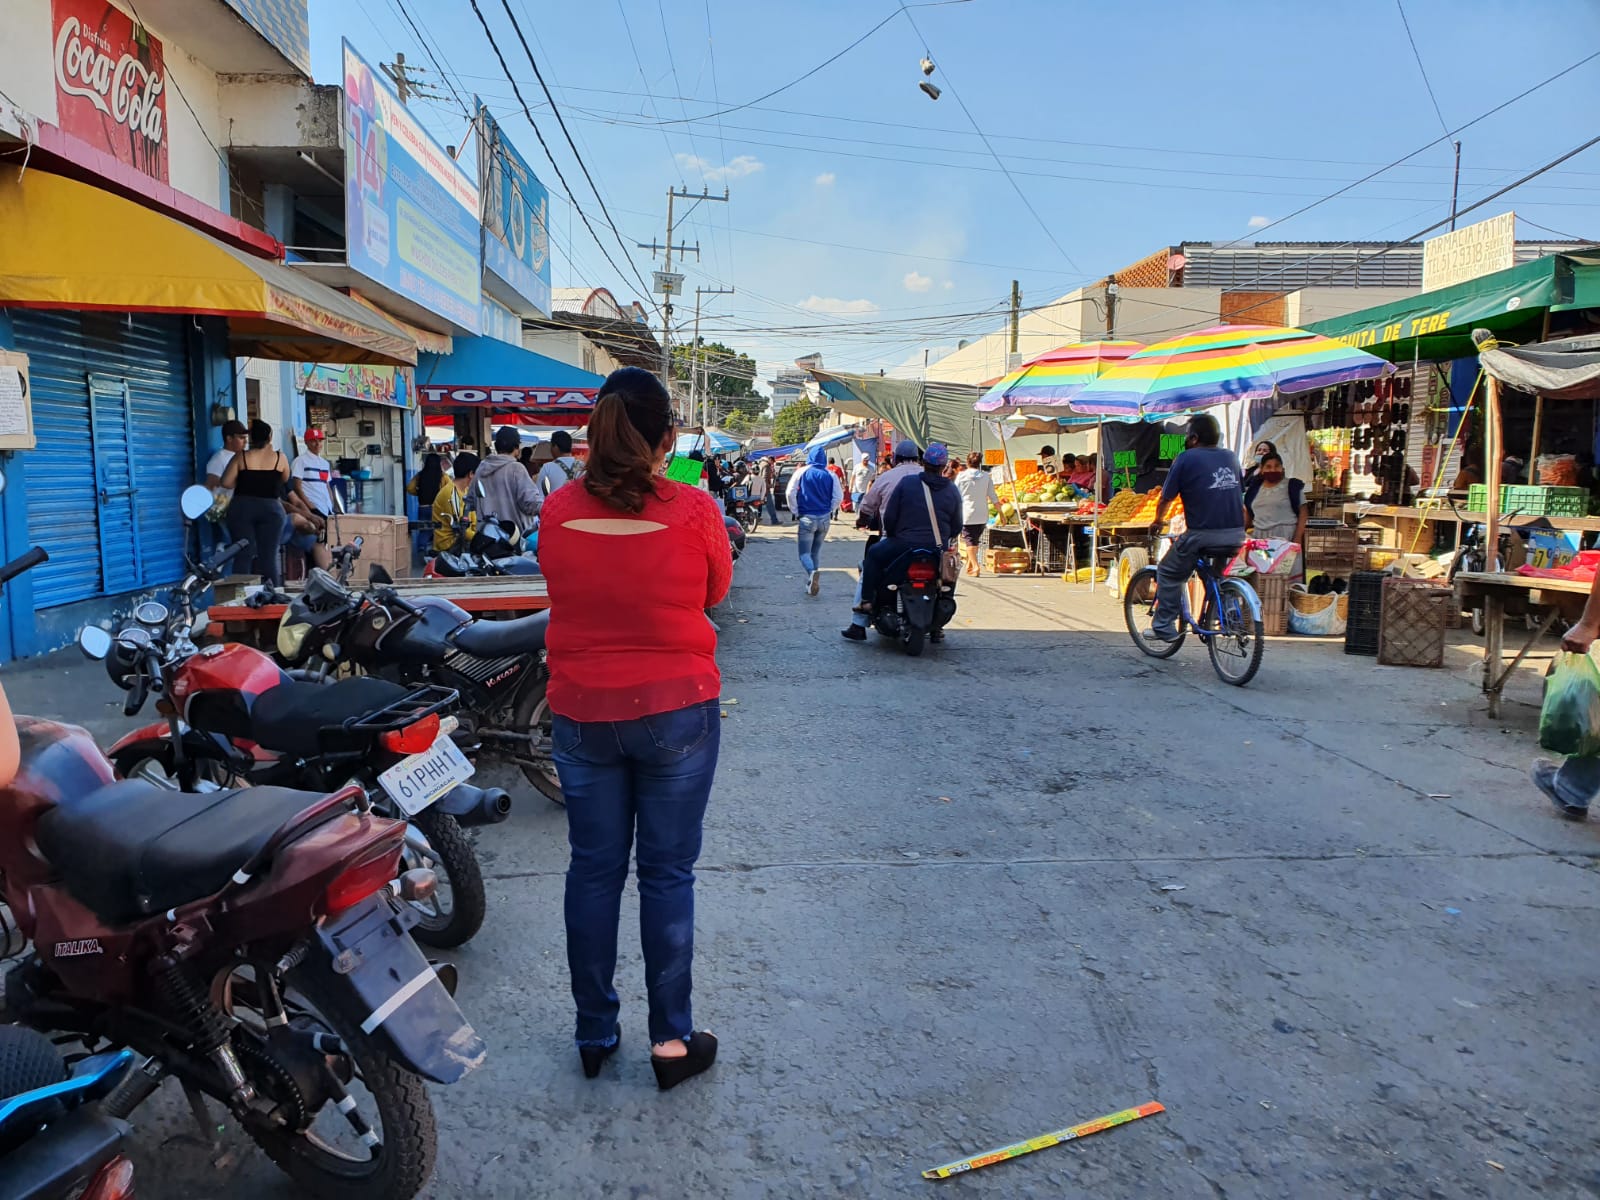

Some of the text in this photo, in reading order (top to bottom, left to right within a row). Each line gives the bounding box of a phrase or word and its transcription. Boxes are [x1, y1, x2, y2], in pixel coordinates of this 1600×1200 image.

[83, 24, 111, 54] Disfruta
[55, 16, 164, 144] Coca-Cola
[350, 108, 380, 194] 14
[1426, 214, 1513, 258] FARMACIA FATIMA
[1383, 323, 1402, 343] DE
[1411, 311, 1451, 337] TERE
[420, 388, 599, 406] TORTA
[398, 750, 459, 799] 61PHH1
[54, 938, 100, 957] ITALIKA
